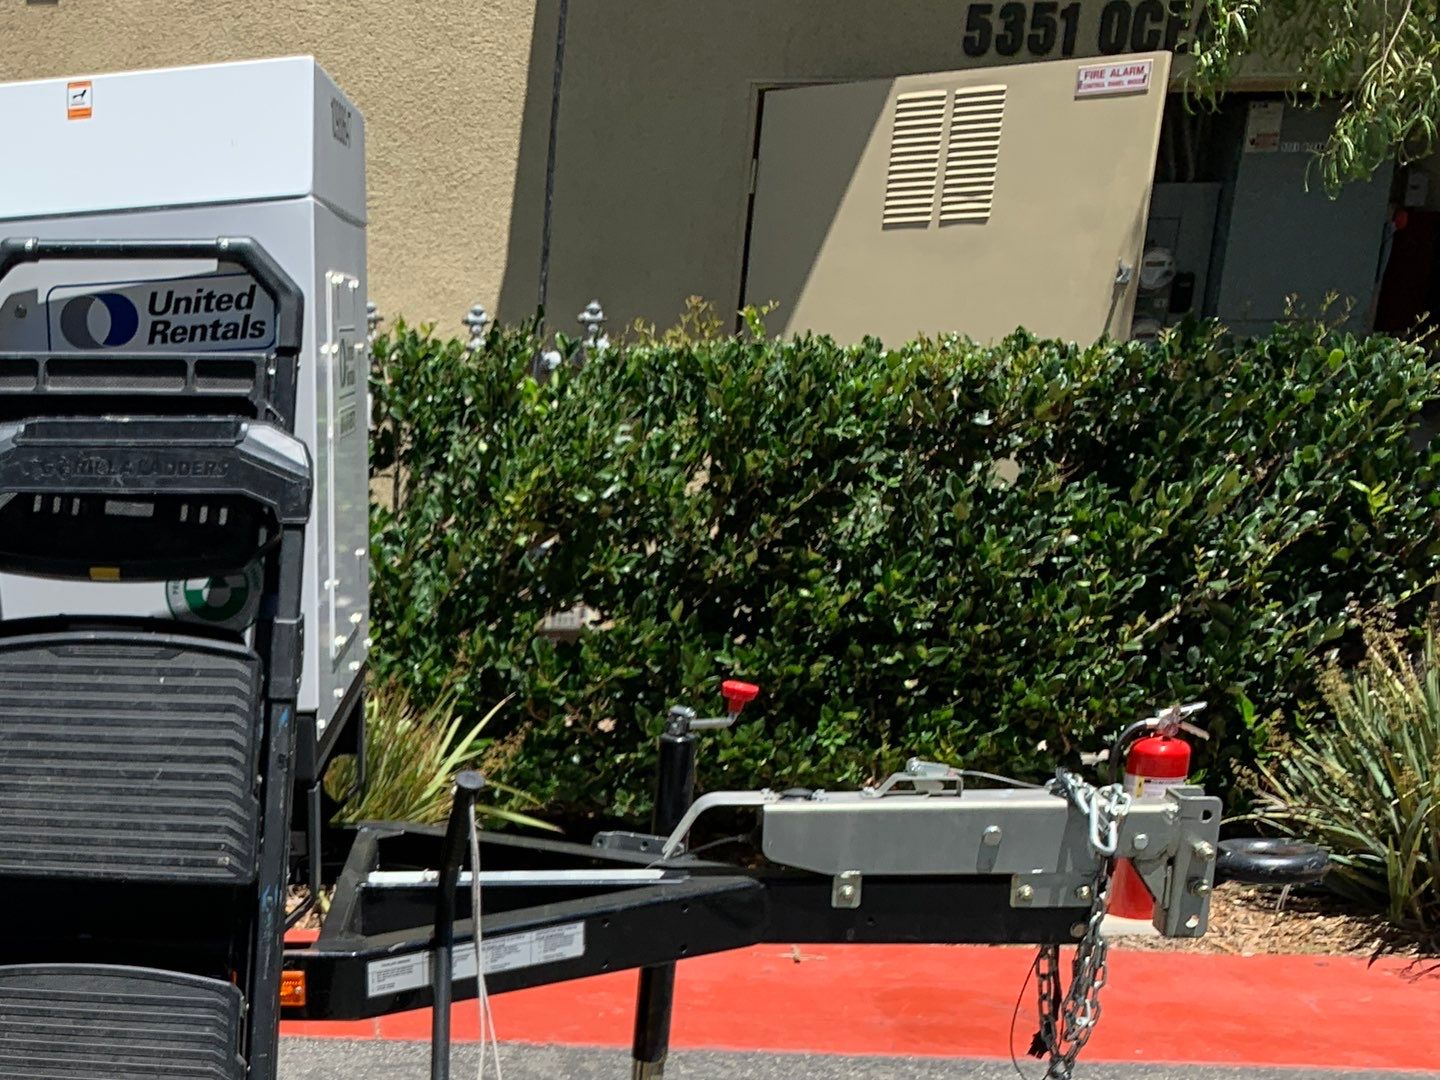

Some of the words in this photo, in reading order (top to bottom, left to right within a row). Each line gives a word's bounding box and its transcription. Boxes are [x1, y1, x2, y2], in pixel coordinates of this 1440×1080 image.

[962, 2, 1081, 57] 5351
[1084, 69, 1105, 80] FIRE
[1110, 65, 1145, 77] ALARM
[148, 284, 257, 317] United
[147, 314, 266, 346] Rentals
